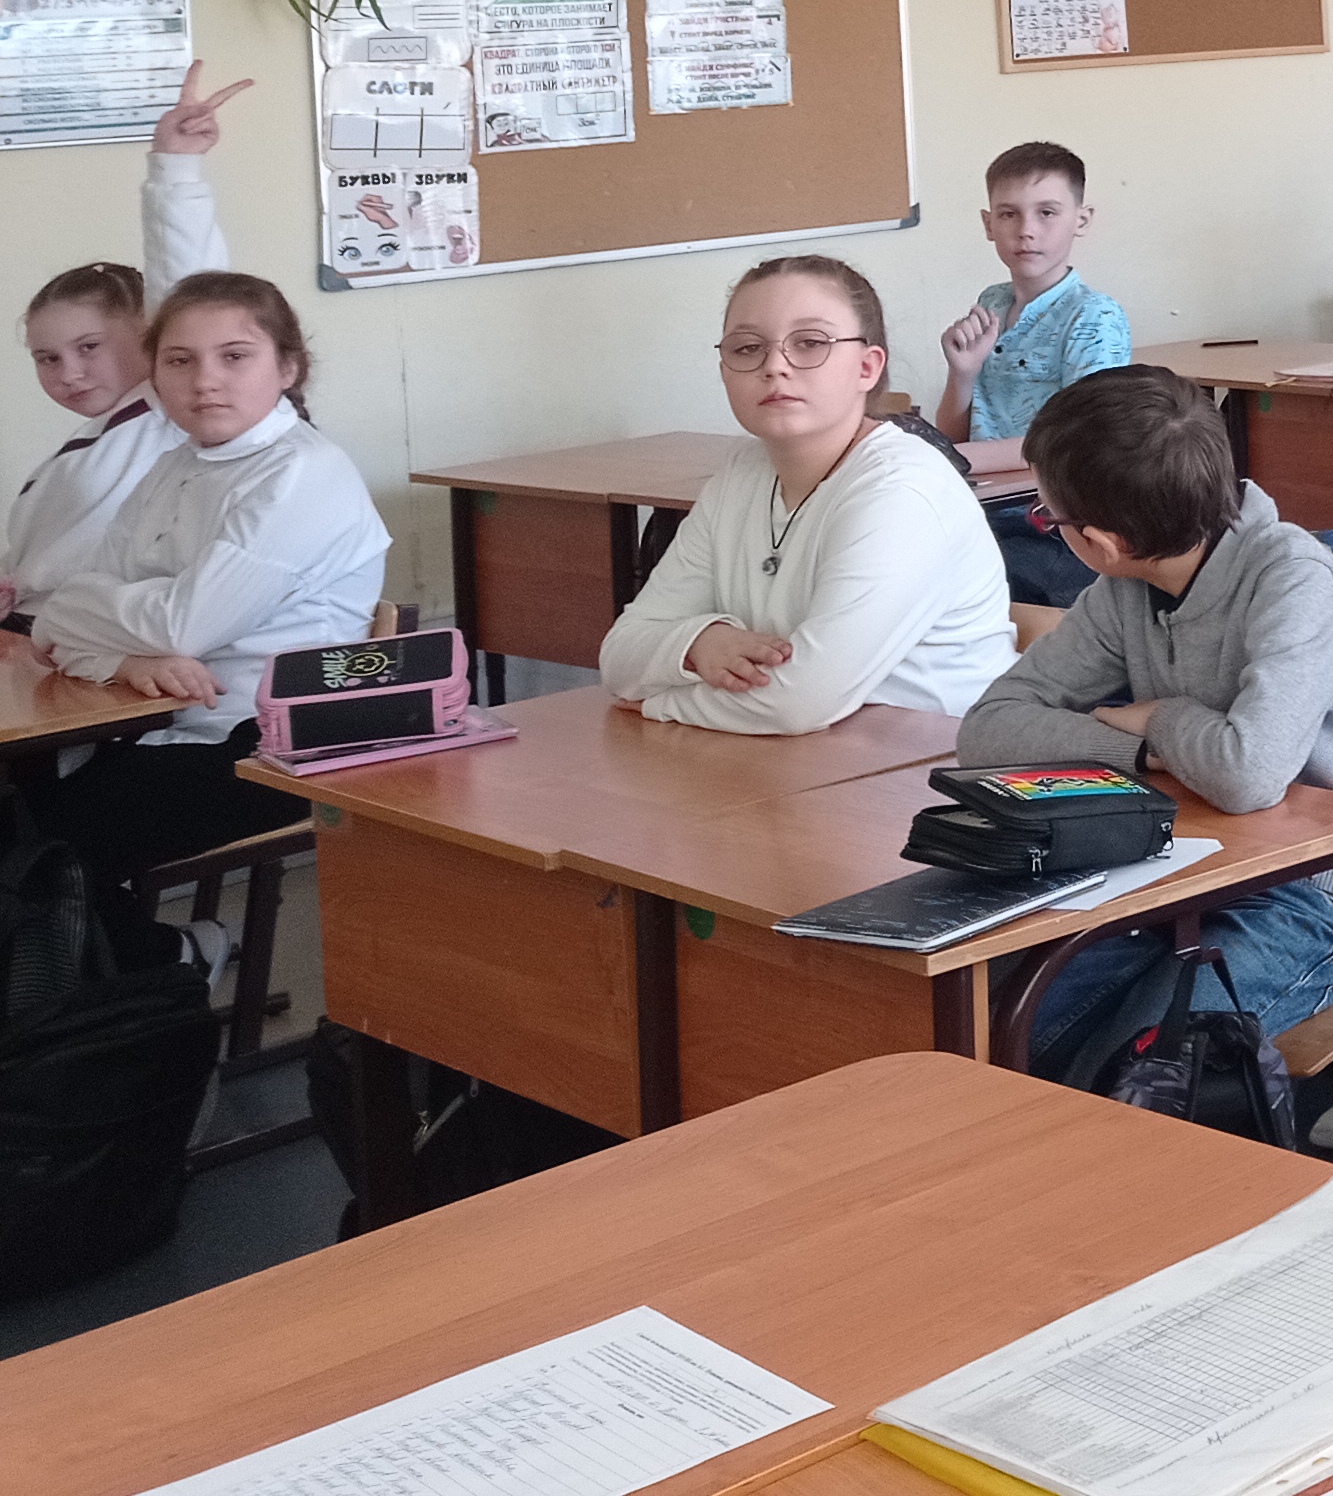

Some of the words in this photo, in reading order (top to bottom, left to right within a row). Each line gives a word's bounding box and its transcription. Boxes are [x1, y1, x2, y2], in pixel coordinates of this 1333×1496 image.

[521, 4, 562, 15] КОТОРОЕ
[563, 3, 613, 13] ЗАНИМАЕТ
[536, 18, 550, 29] НА
[551, 16, 606, 28] ПЛОСКОСТИ
[525, 47, 559, 57] СТОРОНА
[494, 64, 513, 75] ЭТО
[515, 61, 560, 75] ЕДИНИЦА
[366, 81, 434, 96] СЛОГИ
[491, 78, 558, 95] КВАДРАТНЫЙ
[561, 75, 618, 91] САНТИМЕТР
[338, 172, 396, 188] БУКВЫ
[415, 172, 468, 186] ЗВУКИ
